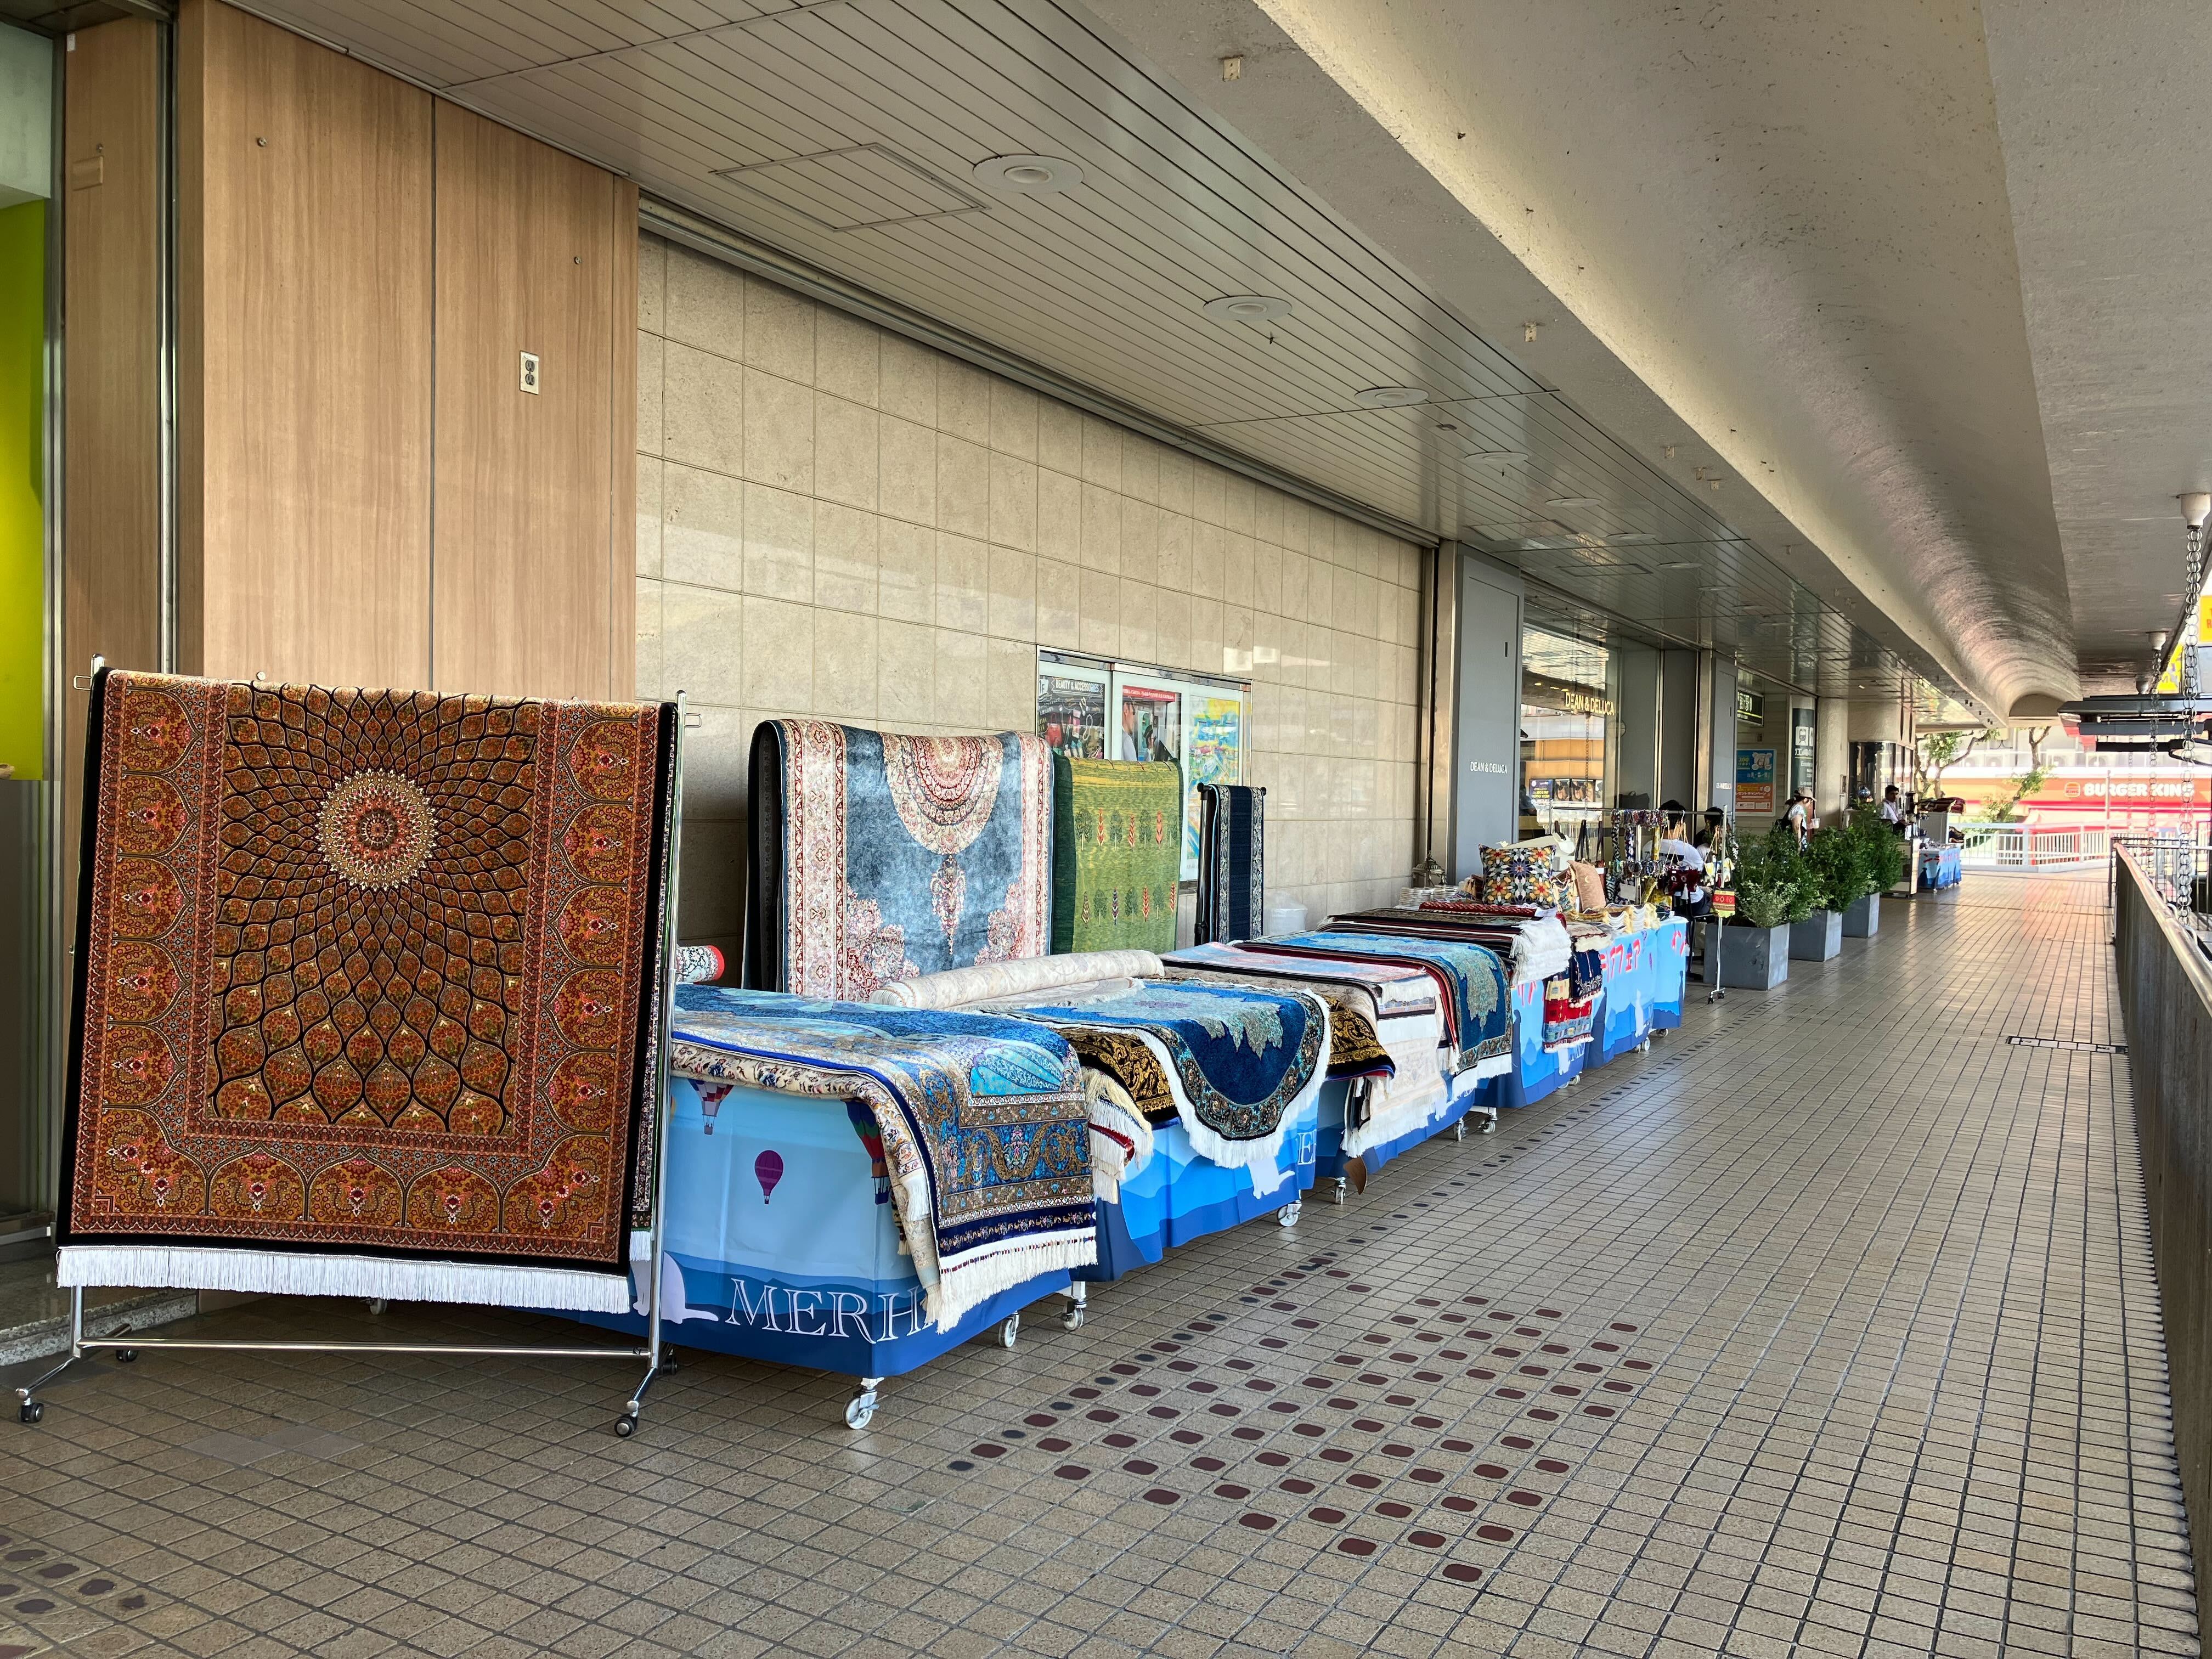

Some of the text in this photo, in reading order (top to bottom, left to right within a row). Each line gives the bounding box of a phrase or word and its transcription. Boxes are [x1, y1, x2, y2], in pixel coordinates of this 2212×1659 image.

[1056, 679, 1099, 693] BEAUTY & ACCESSORIES
[1565, 692, 1615, 716] DEAN & DELUCA
[1470, 761, 1508, 774] DEAN & DELUCA
[2084, 783, 2195, 797] BURGER KING
[725, 1278, 934, 1344] MERH
